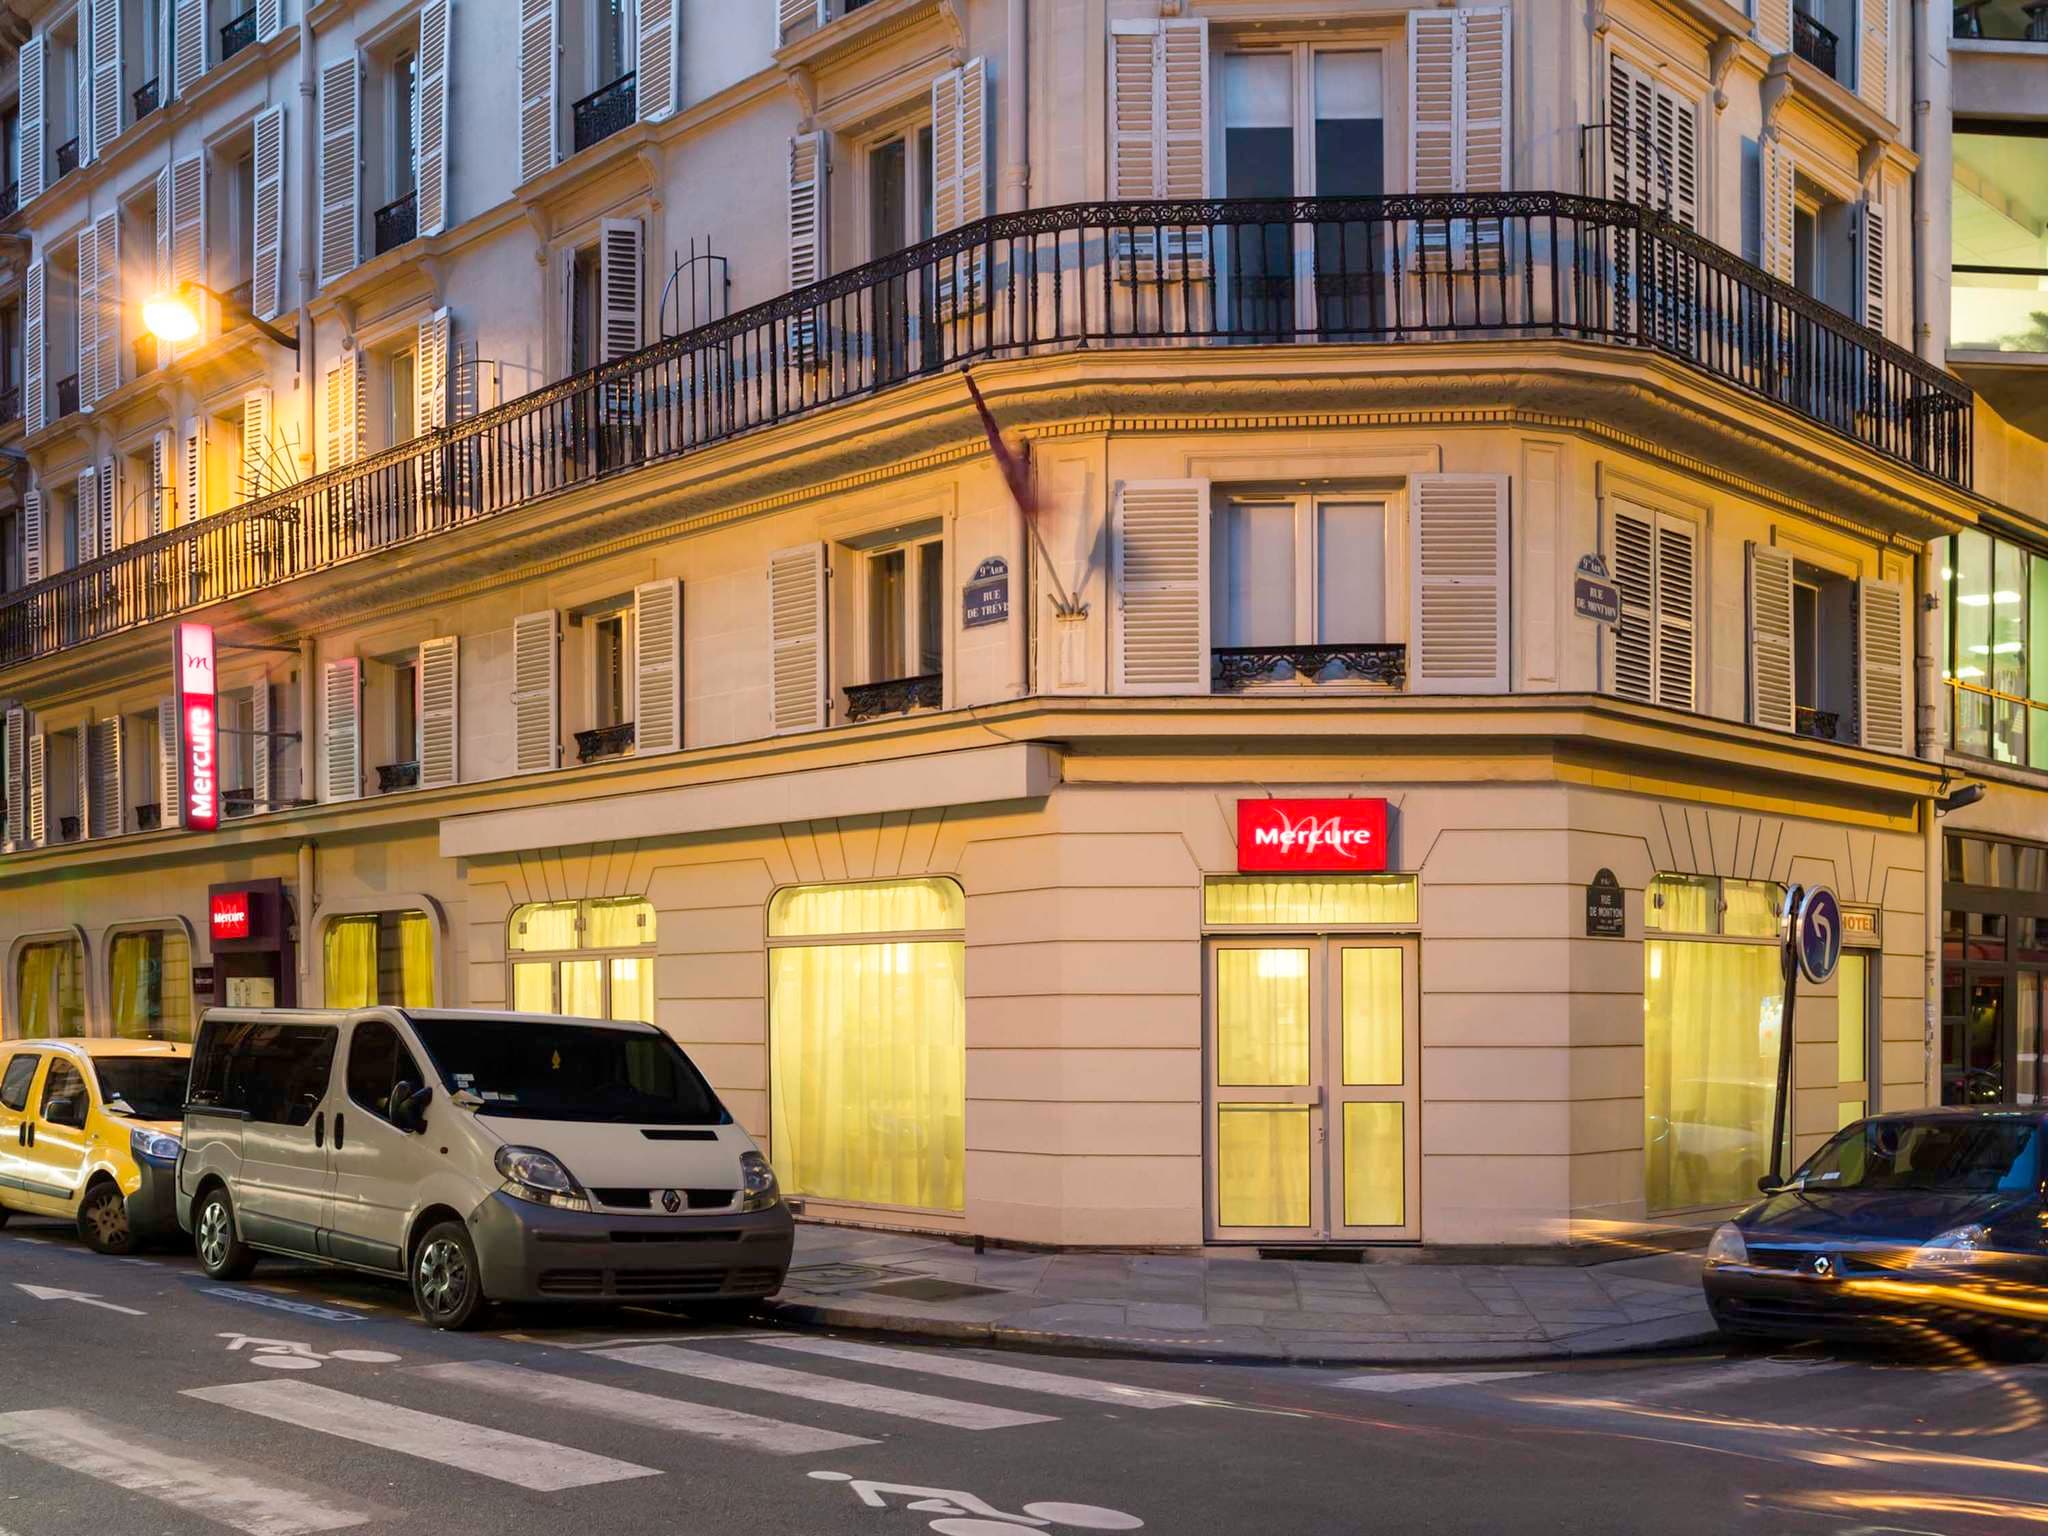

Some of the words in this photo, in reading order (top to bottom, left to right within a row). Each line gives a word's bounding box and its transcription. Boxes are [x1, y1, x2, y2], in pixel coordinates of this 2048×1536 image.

[983, 589, 1001, 602] RUE
[1589, 586, 1605, 600] RUE
[1576, 597, 1588, 610] DE
[967, 607, 979, 619] DE
[190, 706, 213, 818] Mercure
[1254, 826, 1371, 845] Mercure
[1600, 894, 1612, 905] RUE
[213, 911, 245, 924] Mercure
